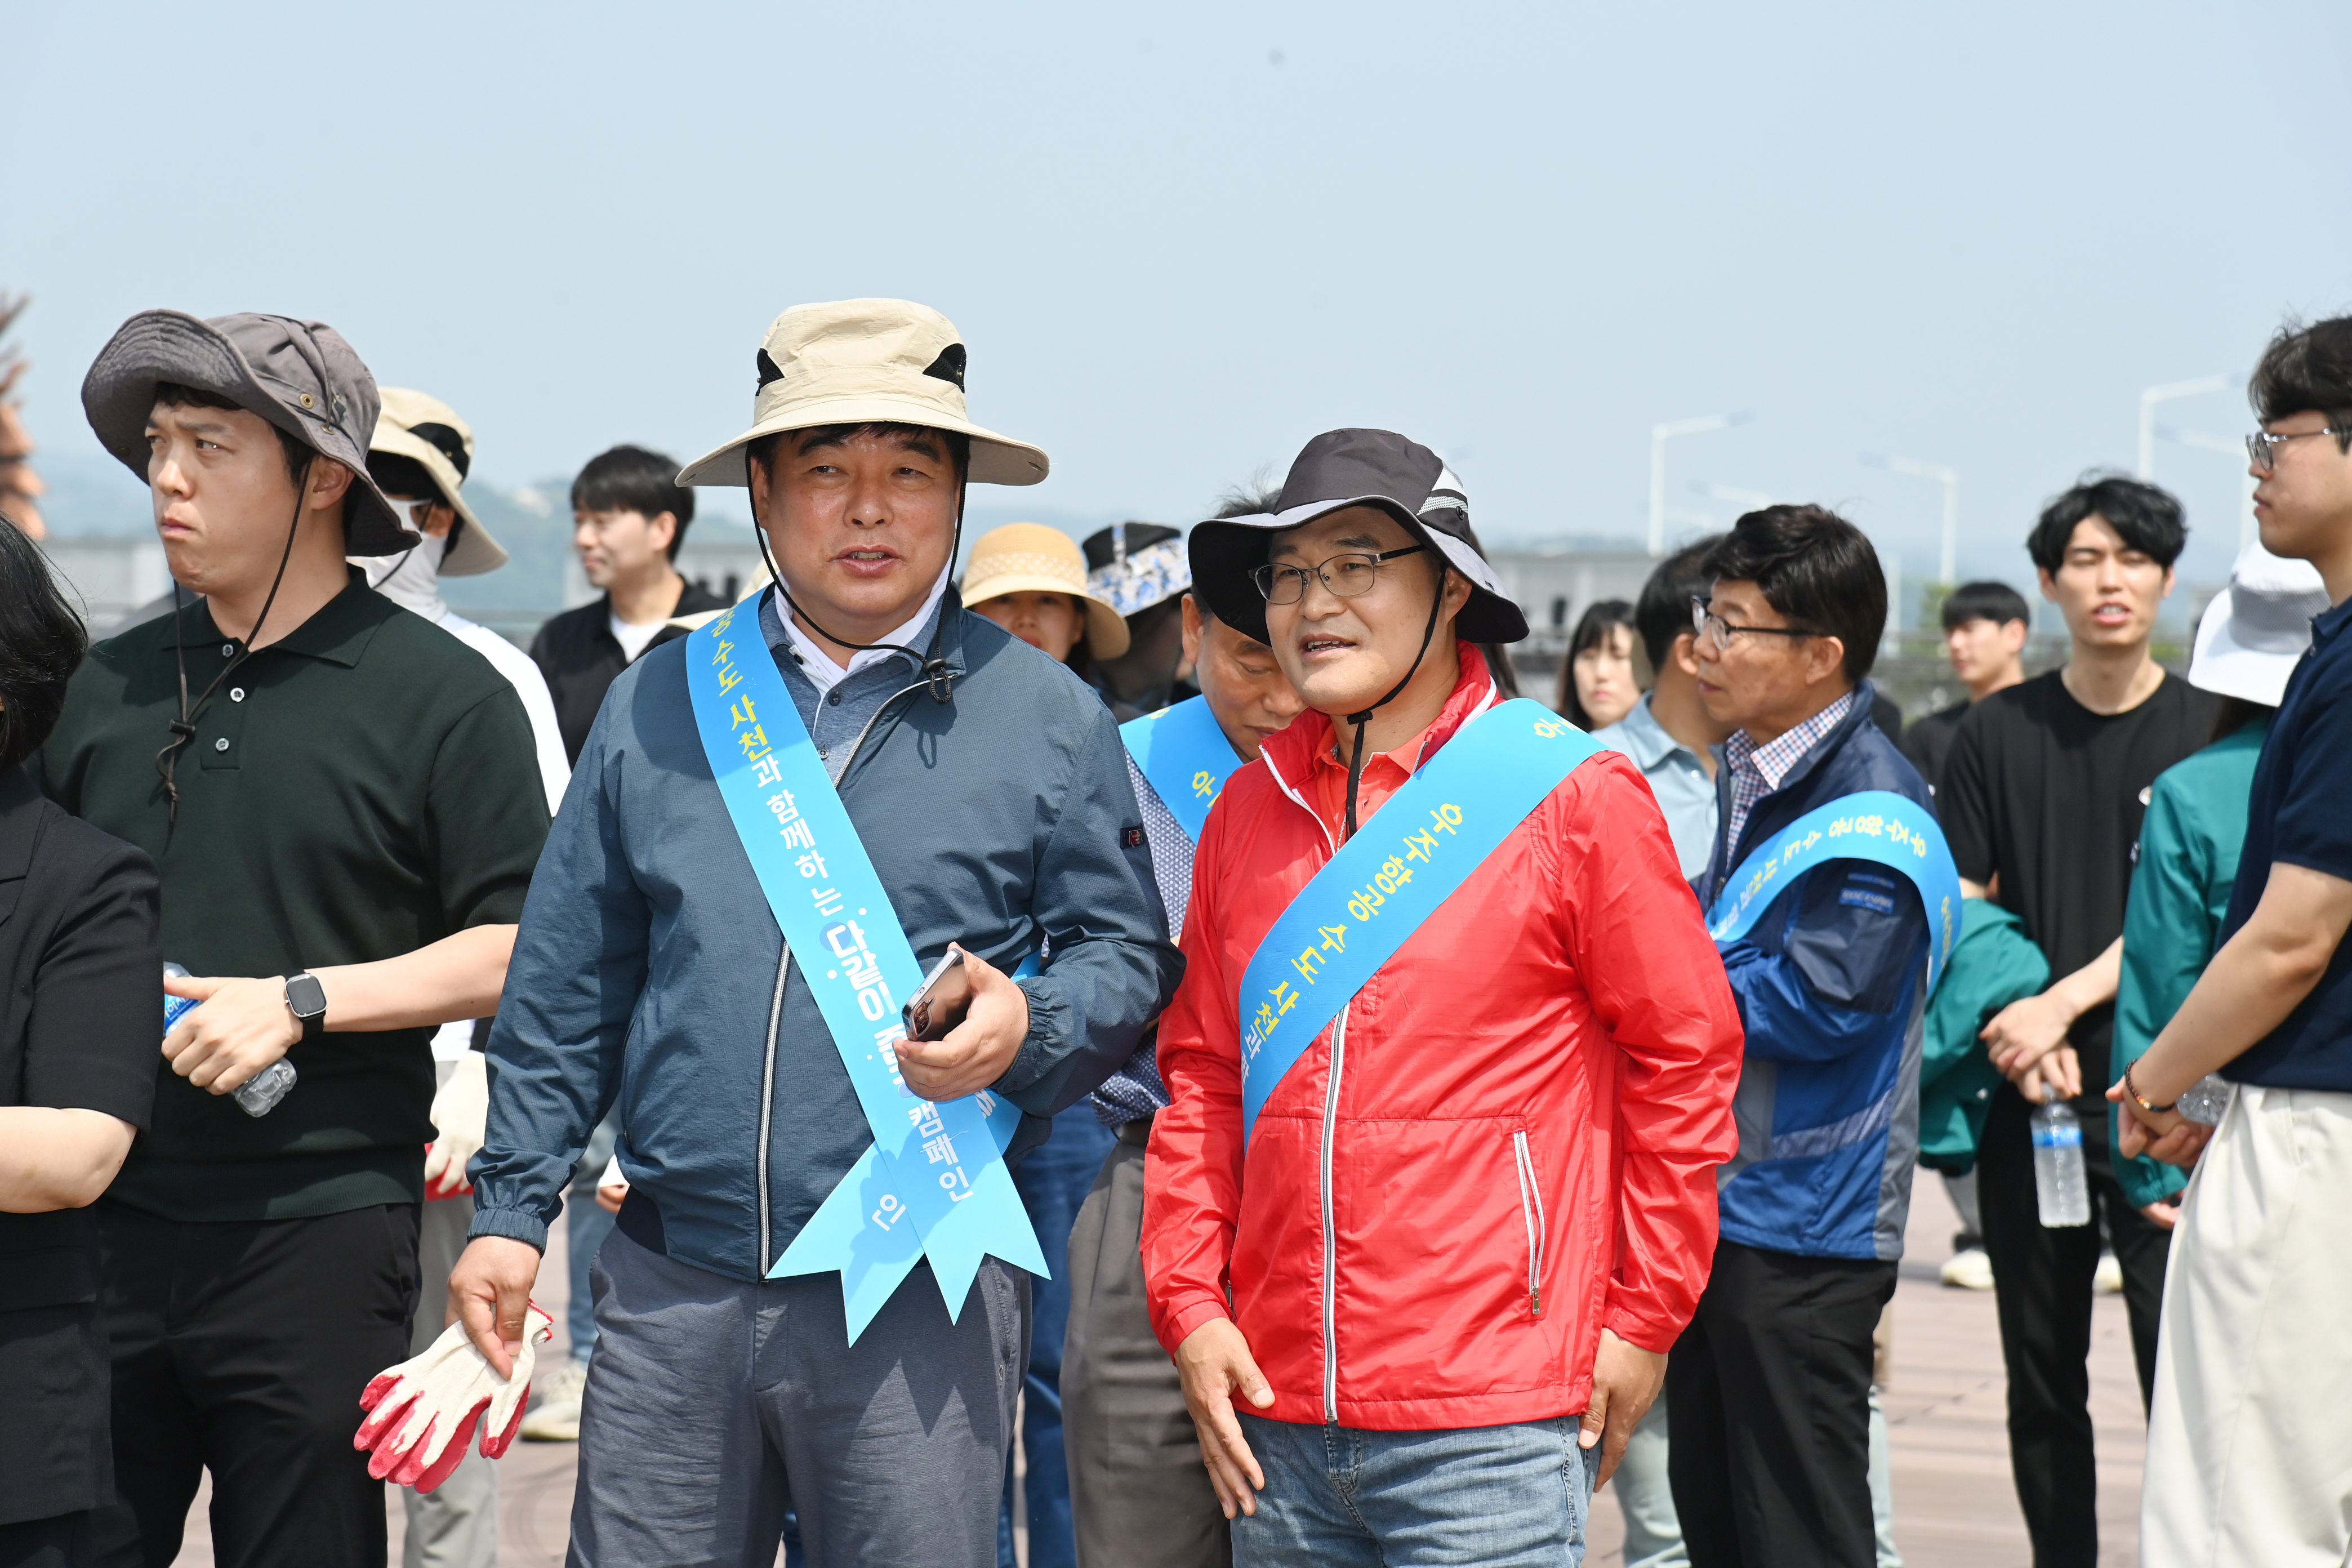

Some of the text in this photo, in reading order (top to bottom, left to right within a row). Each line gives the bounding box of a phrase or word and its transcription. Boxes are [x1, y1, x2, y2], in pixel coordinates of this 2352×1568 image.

[1784, 830, 1822, 866] 수도
[1828, 816, 1927, 857] 우주항공
[711, 639, 743, 697] 수도
[730, 693, 782, 789] 사천과
[765, 789, 844, 917] 함께하는
[825, 919, 898, 1021] 다같이
[907, 1101, 974, 1202] 캠페인
[1245, 803, 1463, 1061] 우주항공 수도 사천과
